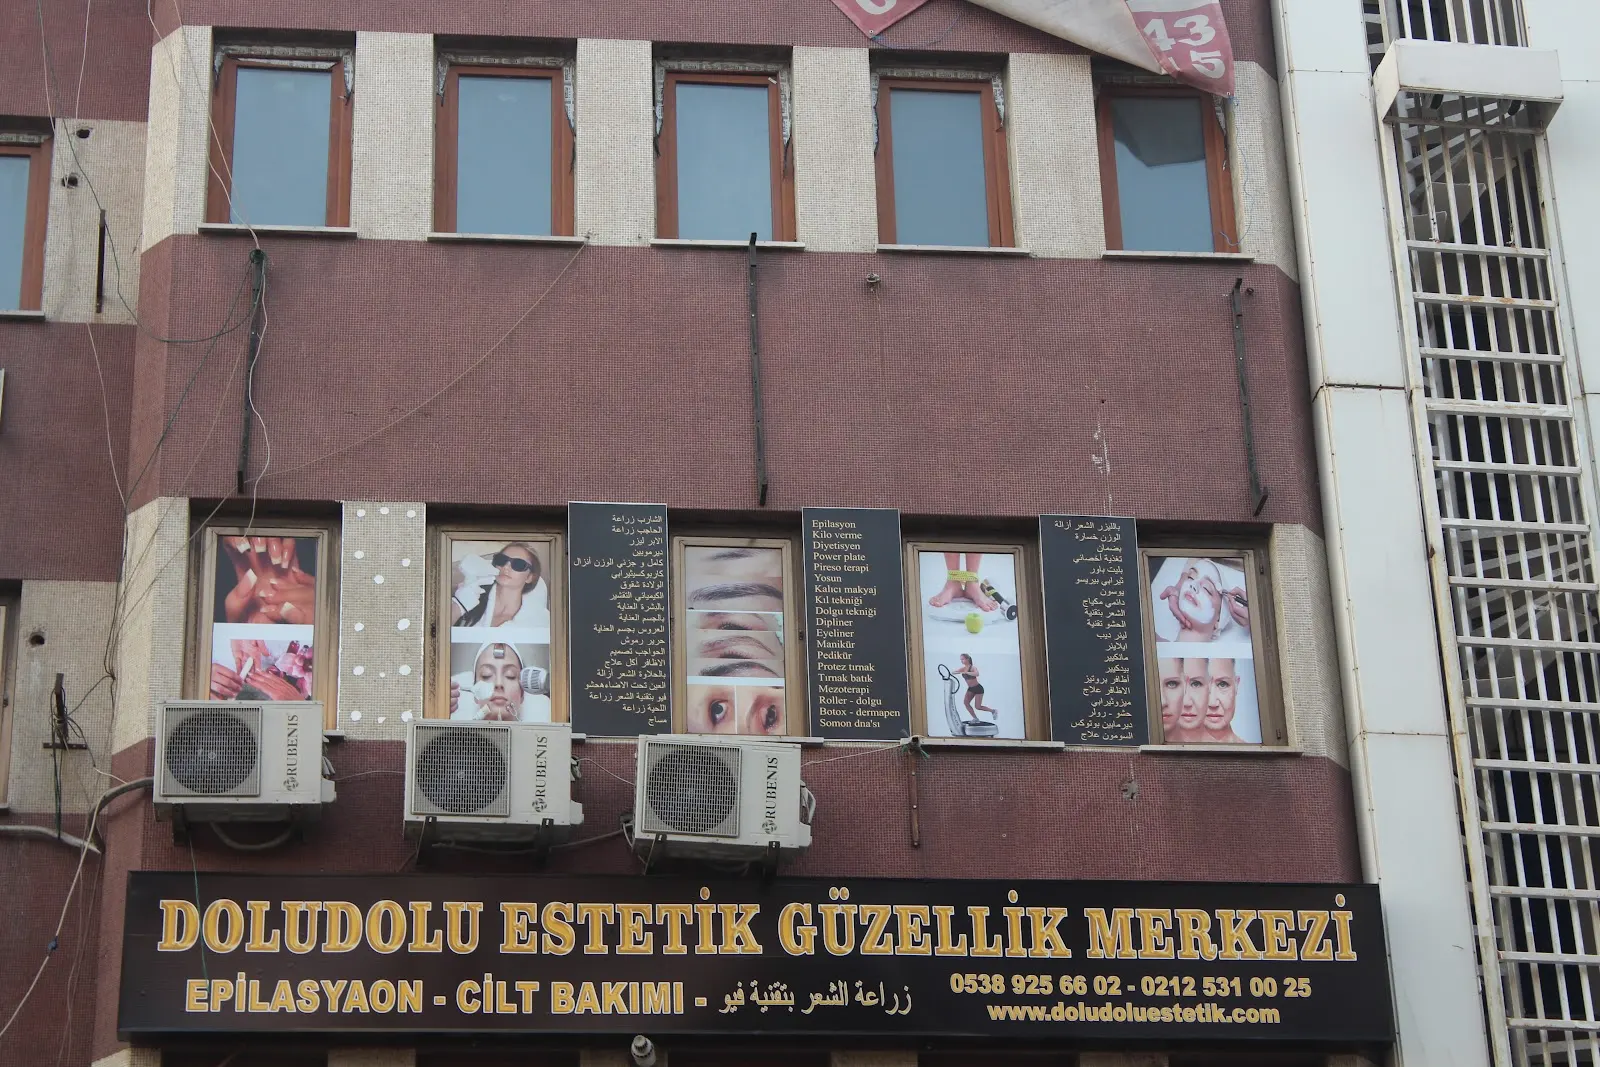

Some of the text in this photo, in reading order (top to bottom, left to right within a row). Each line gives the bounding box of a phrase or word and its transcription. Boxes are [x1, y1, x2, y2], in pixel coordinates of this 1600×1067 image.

[1143, 14, 1216, 52] 43
[612, 515, 635, 524] زراعة
[812, 520, 856, 530] Epilasyon
[612, 526, 635, 535] زراعة
[812, 531, 832, 539] Kilo
[813, 541, 860, 551] Diyetisyen
[813, 552, 866, 562] Power plate
[814, 563, 869, 573] Pireso terapi
[814, 574, 842, 582] Yosun
[814, 585, 877, 596] Kalıcı makyaj
[815, 596, 863, 606] Kıl tekniği
[815, 607, 877, 617] Dolgu tekniği
[816, 618, 853, 627] Dipliner
[816, 629, 854, 639] Eyeliner
[817, 640, 855, 648] Manikür
[817, 651, 852, 660] Pedikür
[817, 662, 875, 671] Protez tırnak
[818, 673, 873, 683] Tırnak batık
[819, 685, 869, 695] Mezoterapi
[819, 696, 847, 704] Roller
[856, 697, 882, 707] dolgu
[820, 707, 847, 716] Botox
[856, 708, 900, 719] dermapen
[820, 718, 852, 728] Somon
[286, 714, 299, 776] RUBENIS
[535, 735, 548, 798] RUBENIS
[765, 756, 778, 820] RUBENIS
[157, 886, 1358, 962] DOLUDOLU ESTETİK GÜZELLİK MERKEZİ
[949, 972, 1006, 995] 0538
[1011, 974, 1054, 996] 925
[1059, 974, 1089, 996] 66
[1093, 975, 1123, 997] 02
[1140, 976, 1197, 997] 0212
[1201, 976, 1243, 998] 531
[1249, 977, 1279, 998] 00
[1283, 977, 1313, 999] 25
[185, 971, 423, 1014] EPİLASYAON
[456, 972, 540, 1015] CİLT
[550, 980, 685, 1015] BAKIMI
[718, 980, 912, 1015] زراعة الشعر بتقنية فيو
[987, 1001, 1281, 1025] www.doludoluestetik.com
